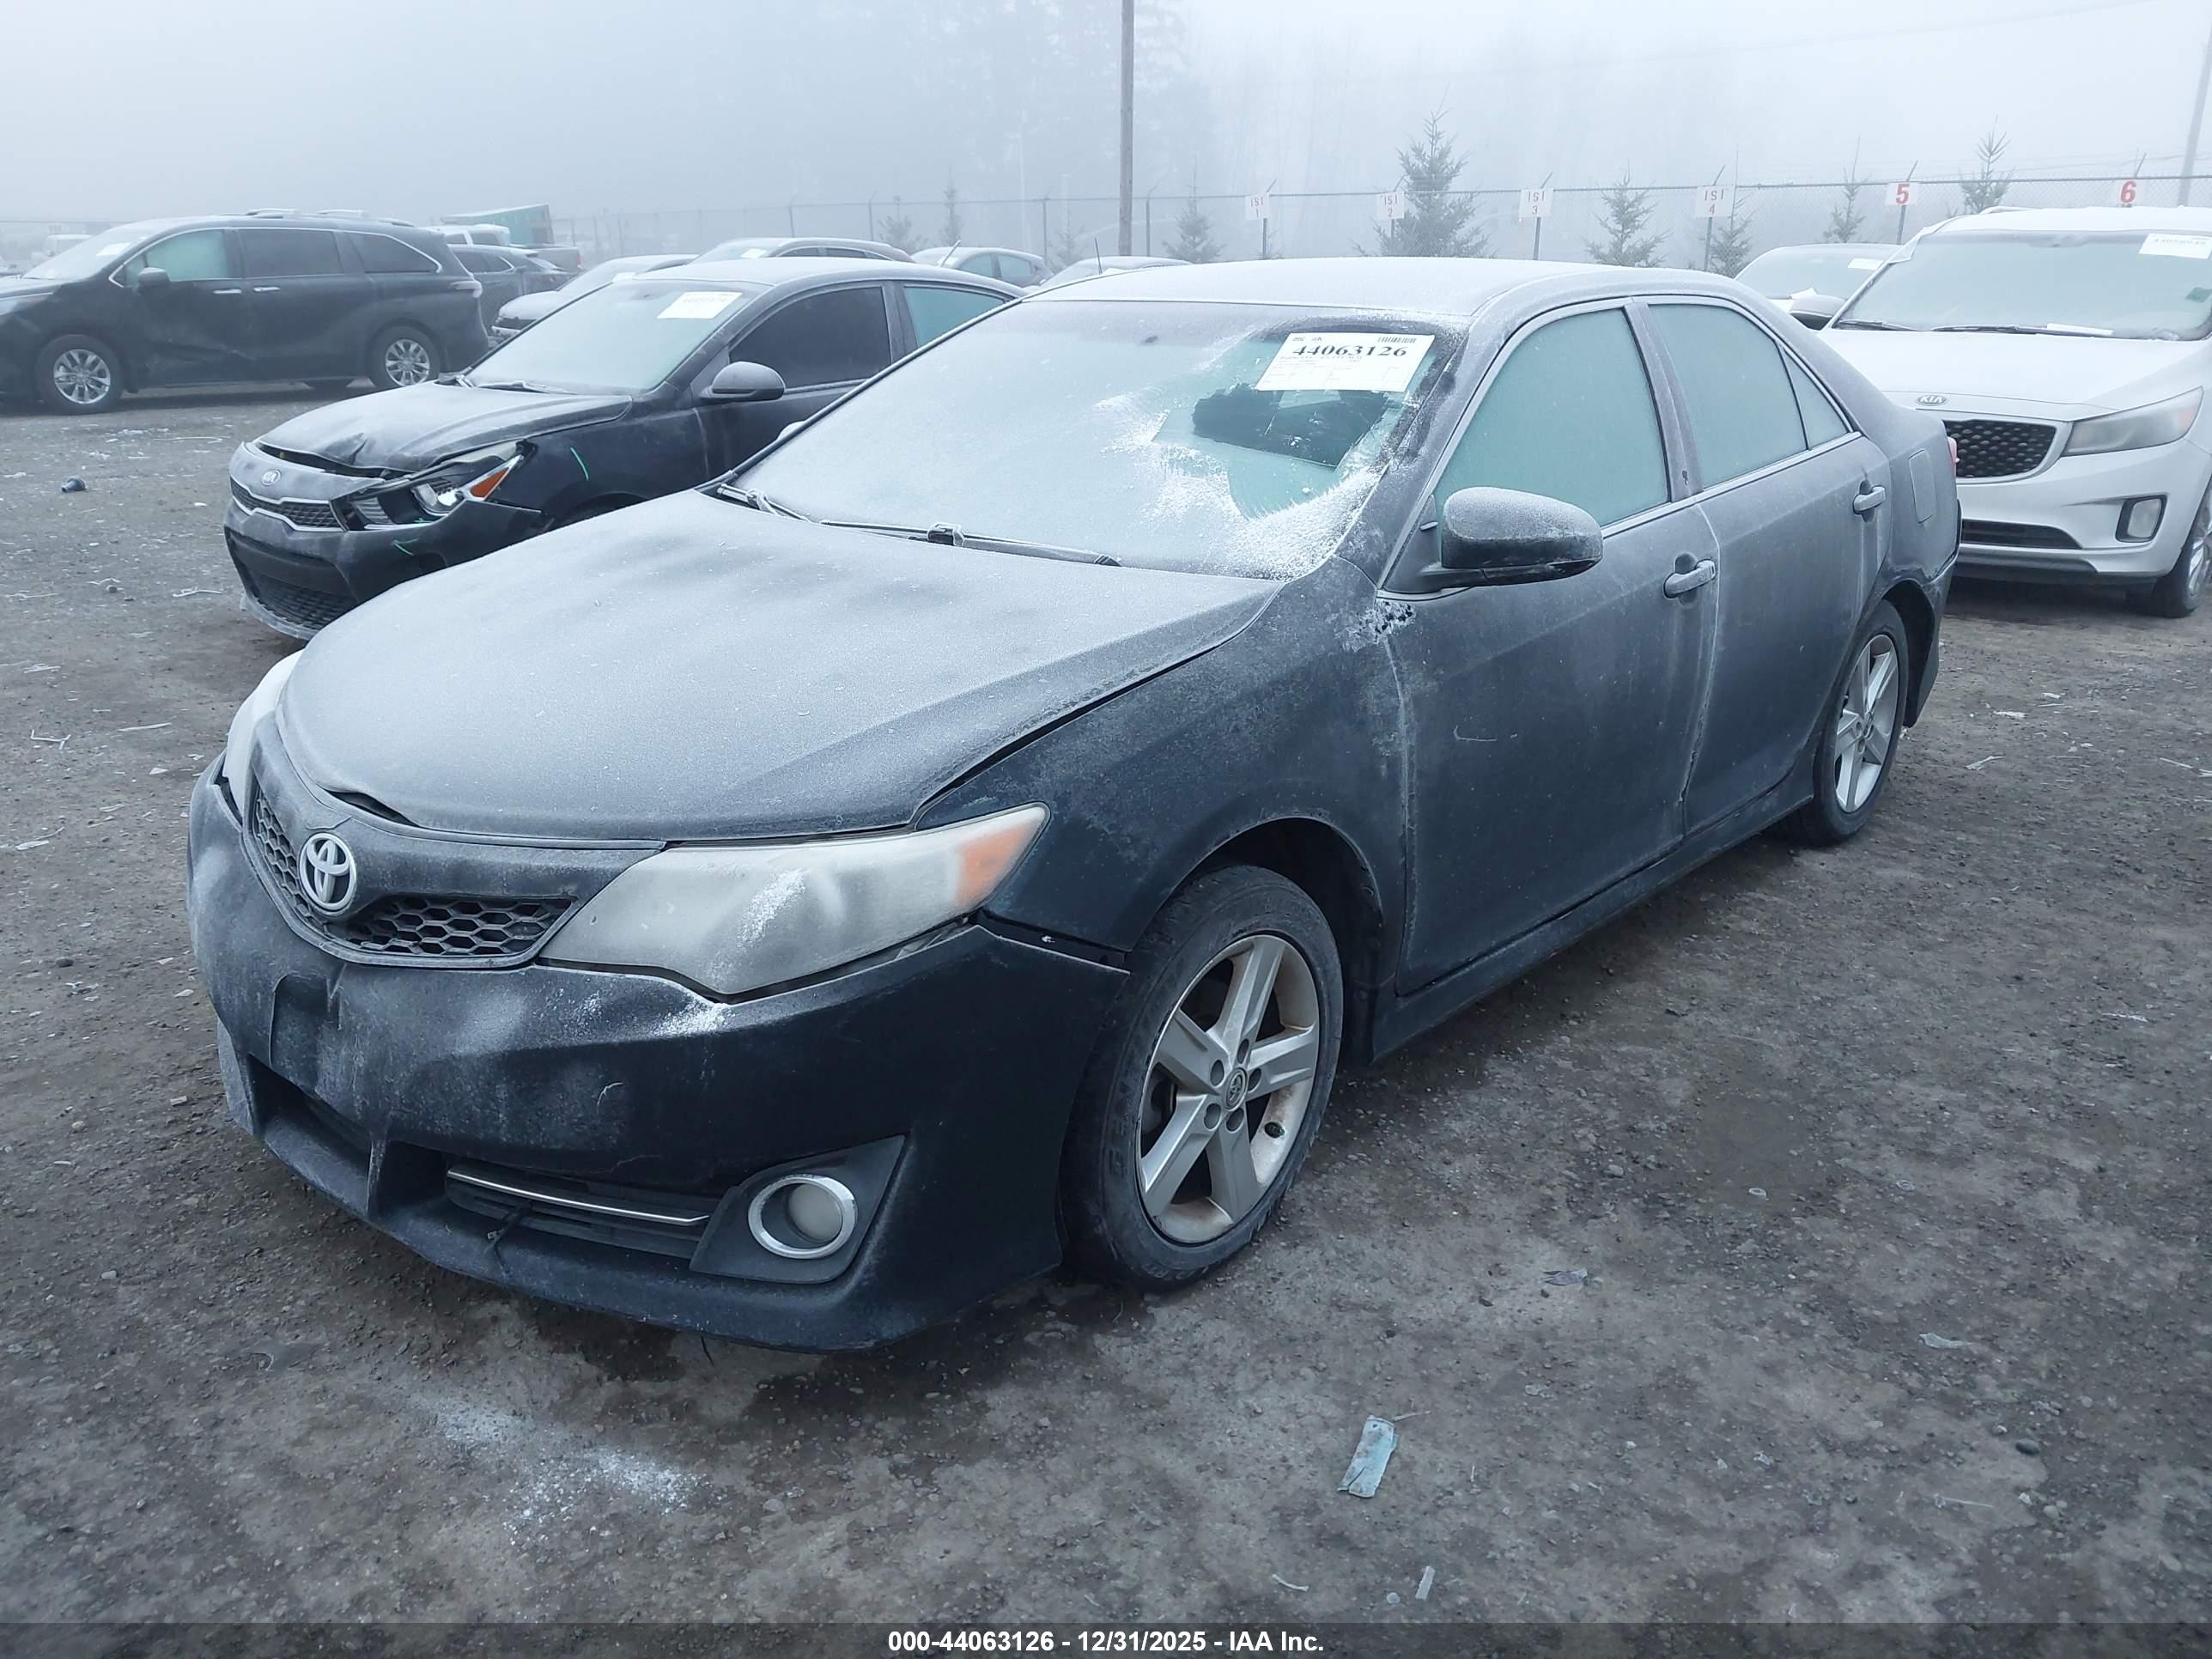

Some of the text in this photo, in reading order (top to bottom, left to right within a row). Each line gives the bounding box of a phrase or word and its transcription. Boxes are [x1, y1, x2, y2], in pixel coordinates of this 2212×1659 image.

[1895, 183, 1911, 204] 5
[2119, 180, 2137, 204] 6
[1531, 205, 1539, 216] 3
[1709, 204, 1716, 216] 4
[1292, 345, 1409, 357] 44063126
